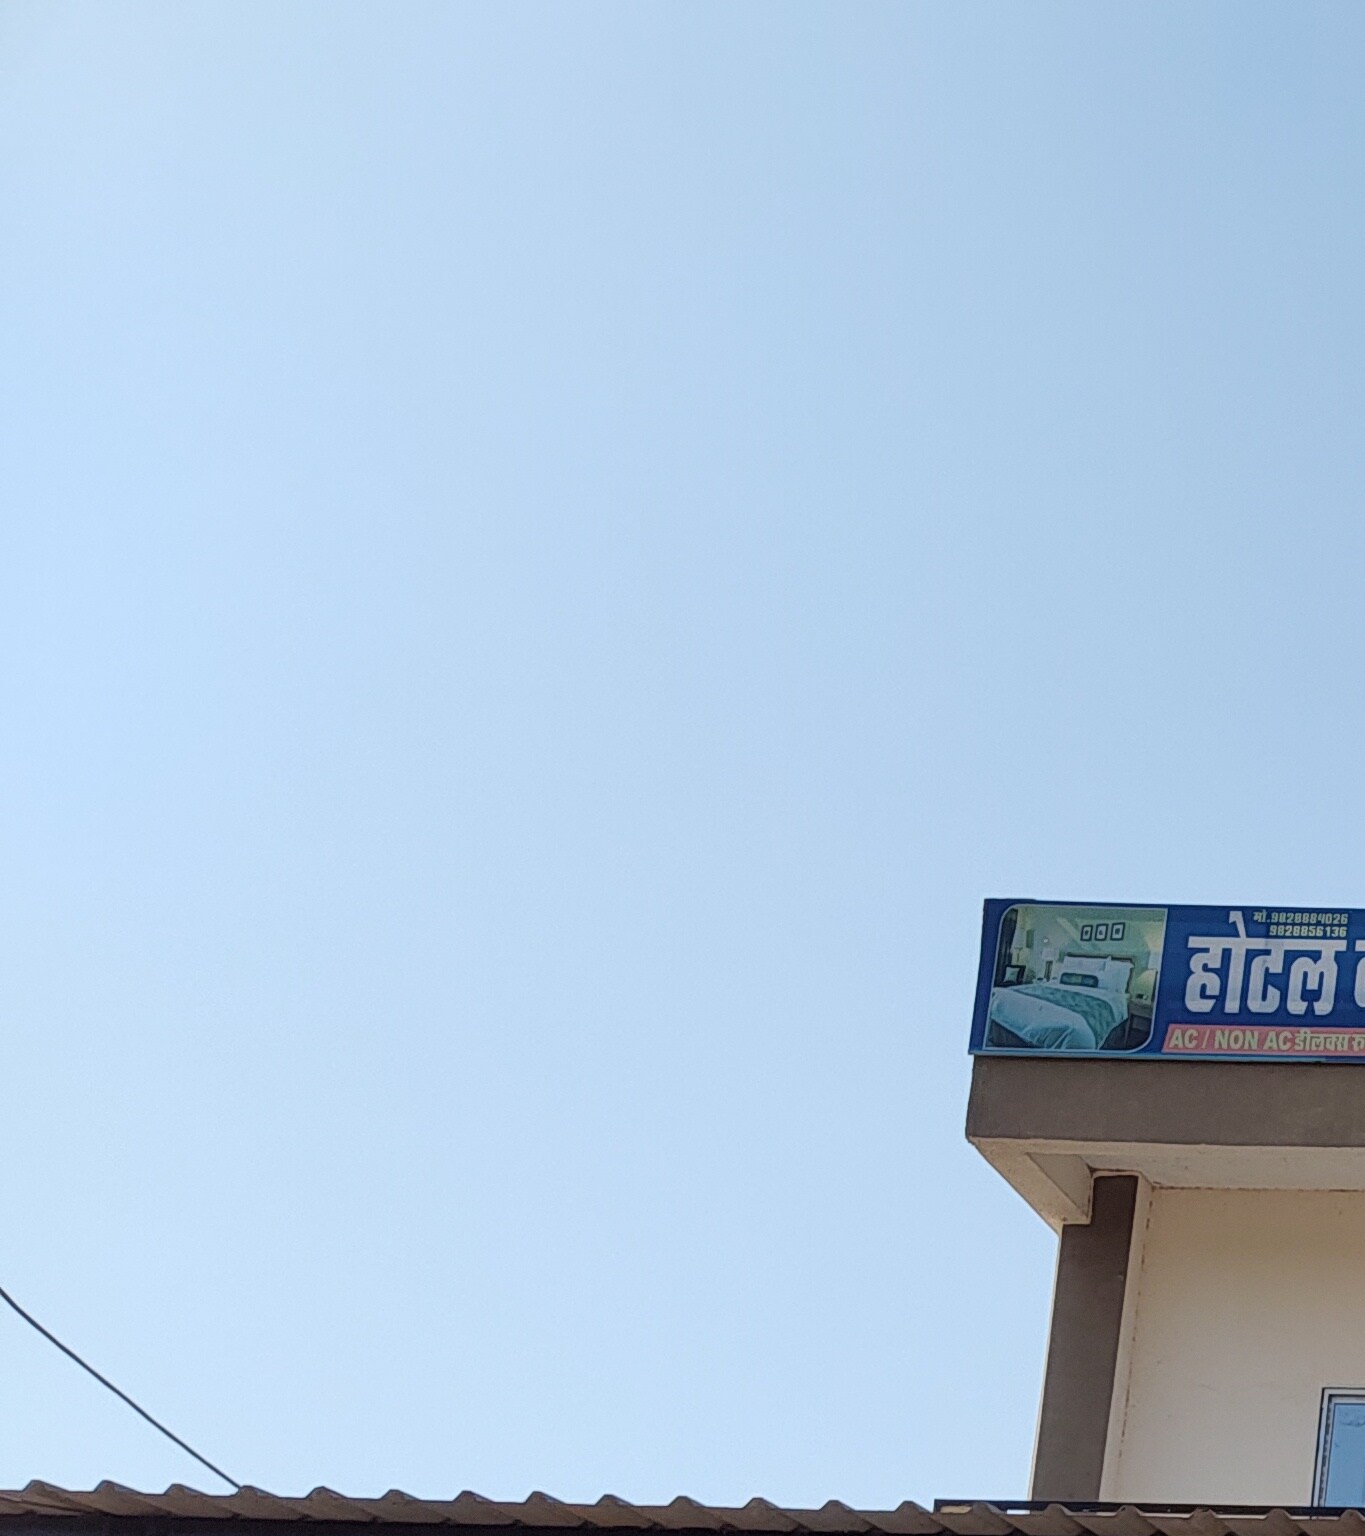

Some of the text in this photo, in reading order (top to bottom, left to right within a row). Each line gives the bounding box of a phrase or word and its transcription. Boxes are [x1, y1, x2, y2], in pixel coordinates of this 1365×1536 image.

[1185, 910, 1348, 1016] होटल
[1169, 1028, 1198, 1048] AC
[1214, 1029, 1259, 1049] NON
[1263, 1030, 1294, 1050] AC
